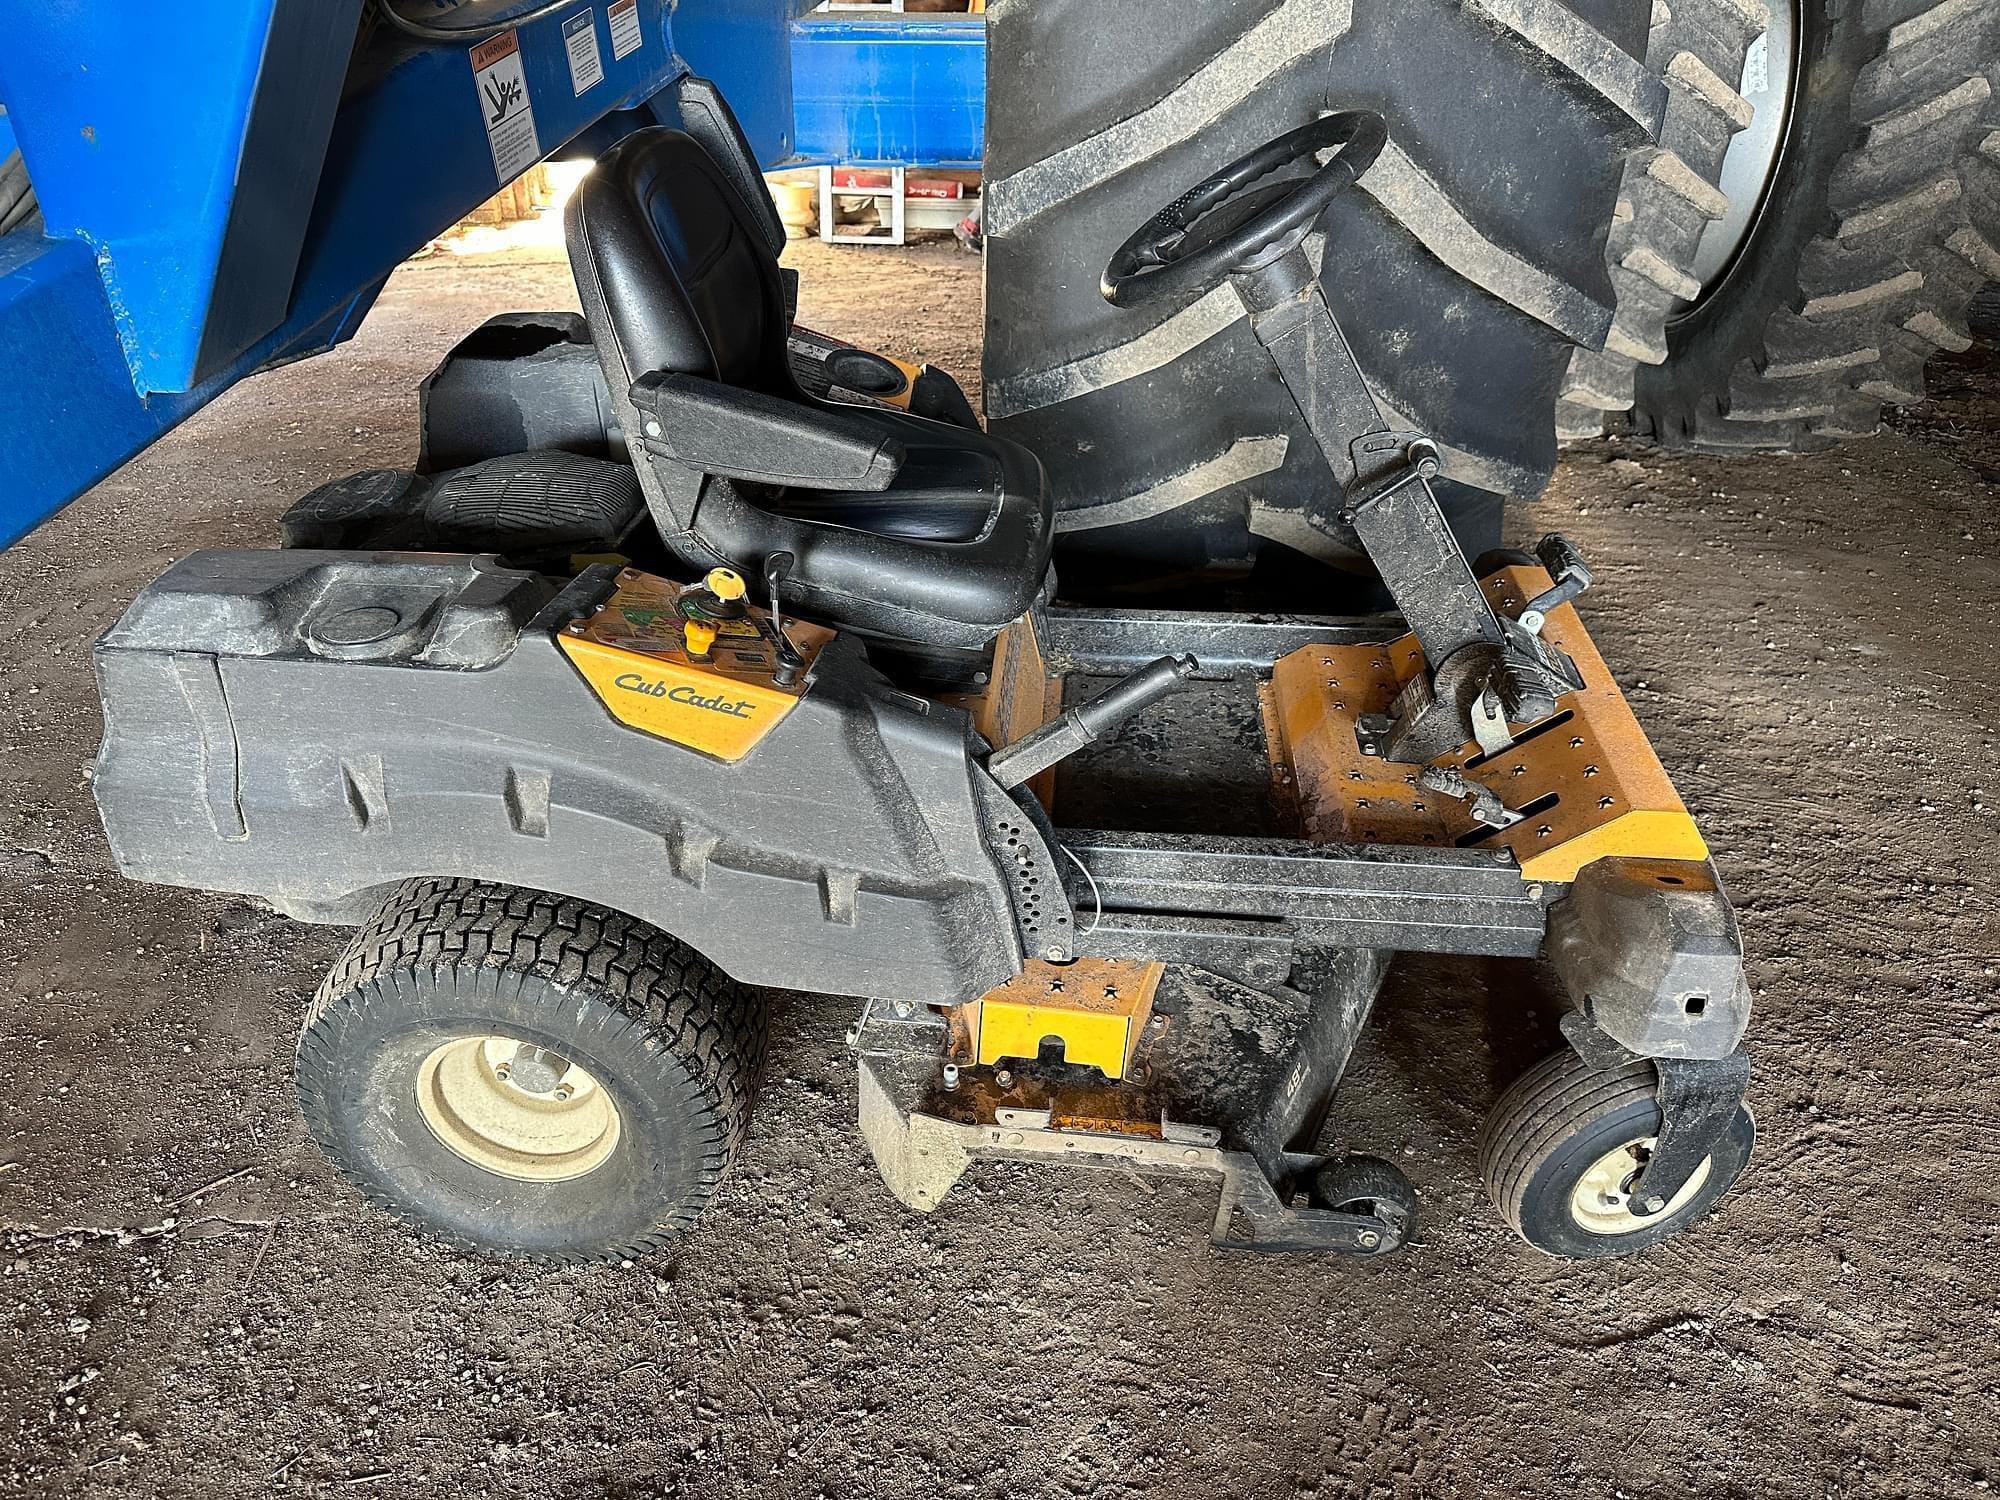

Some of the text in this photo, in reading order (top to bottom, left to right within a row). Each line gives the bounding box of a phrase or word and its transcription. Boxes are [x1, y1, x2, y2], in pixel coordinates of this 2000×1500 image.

[484, 36, 513, 59] WARNING
[614, 673, 757, 719] Cub Cadet
